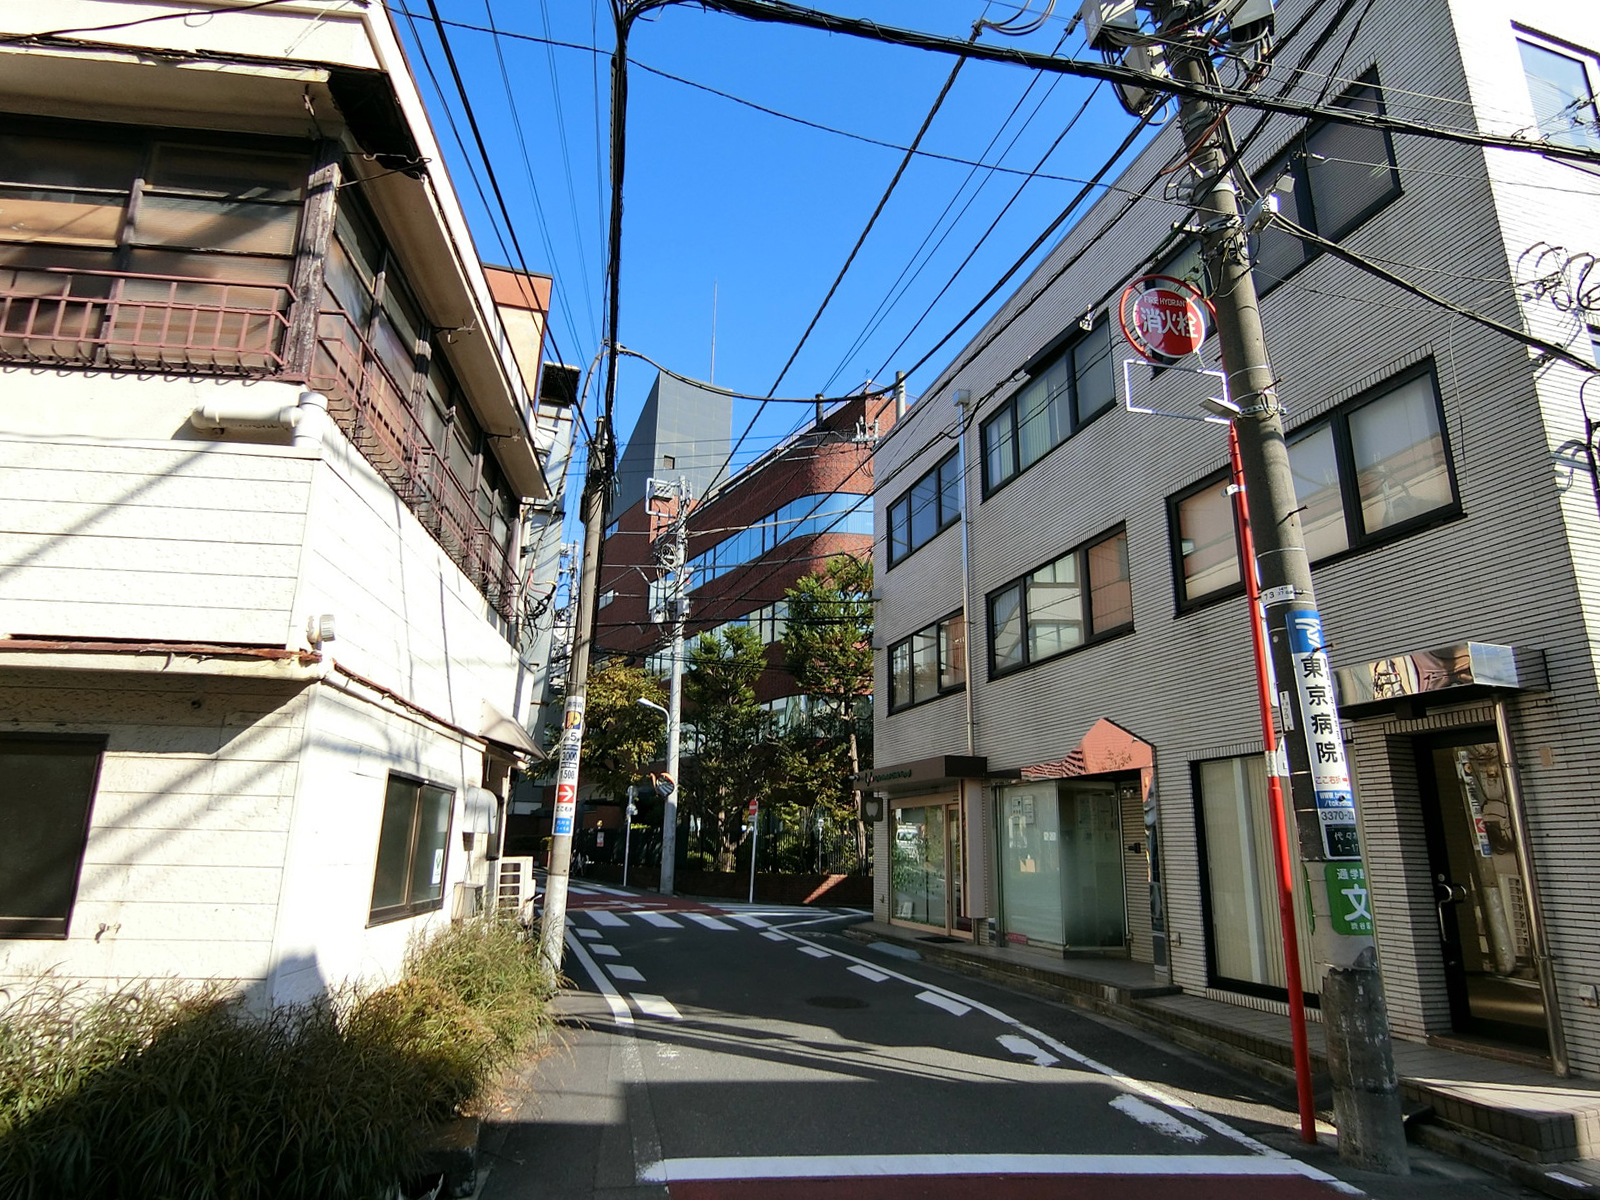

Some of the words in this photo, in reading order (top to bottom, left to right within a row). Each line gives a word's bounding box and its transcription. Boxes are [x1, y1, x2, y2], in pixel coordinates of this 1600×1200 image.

[1144, 295, 1159, 305] FIRE
[1141, 307, 1198, 338] 消火栓
[1301, 656, 1338, 764] 東京病院
[1341, 883, 1372, 921] 文
